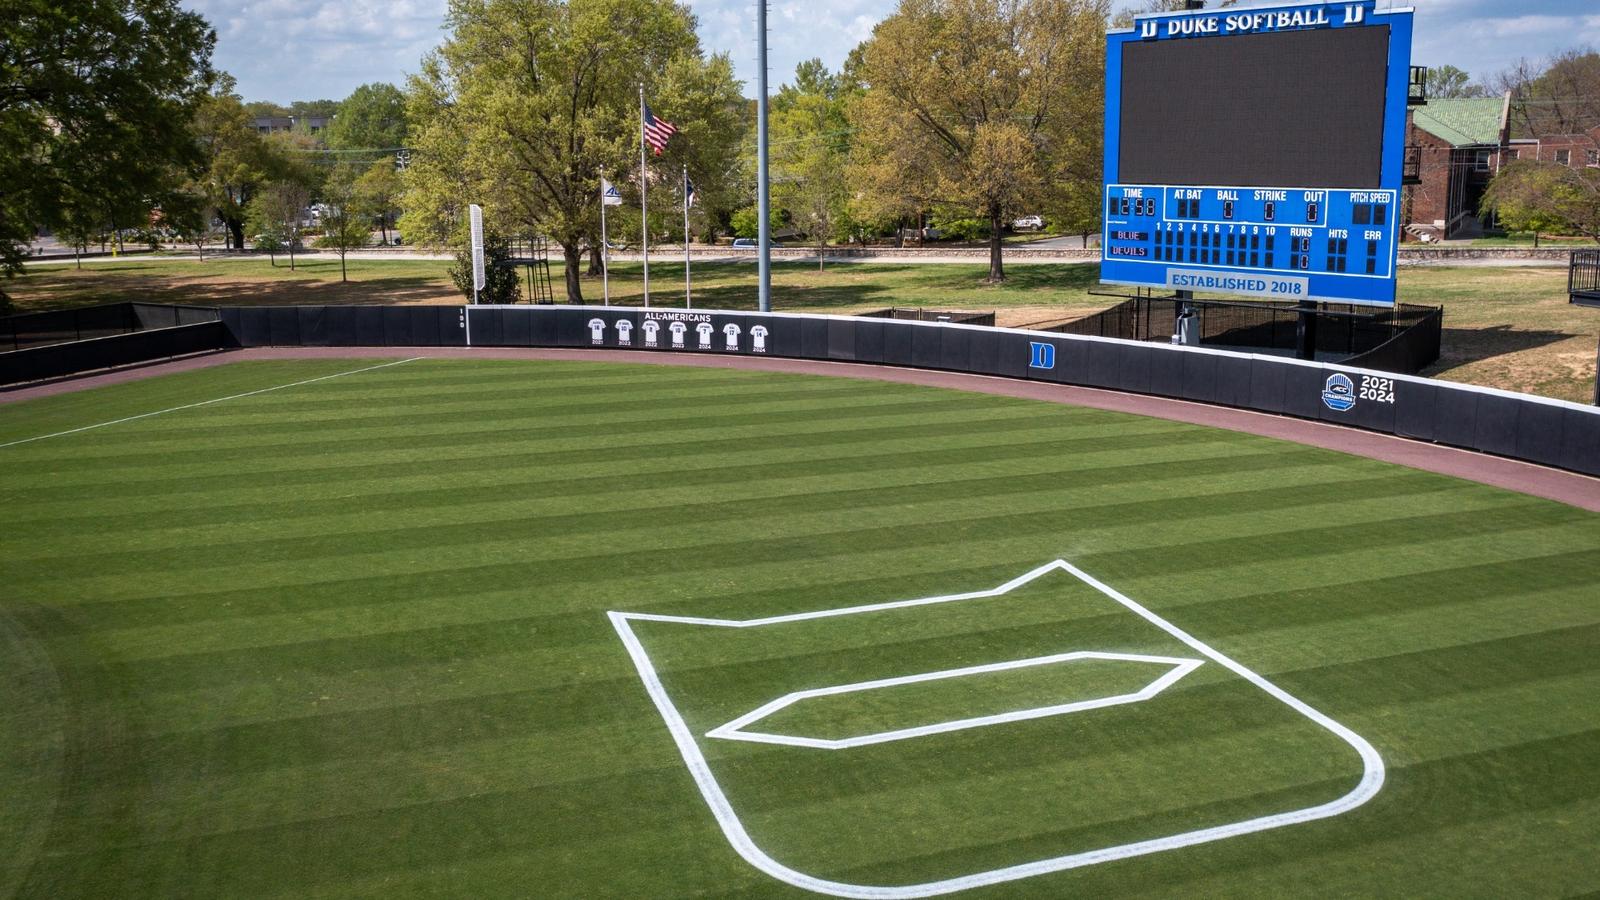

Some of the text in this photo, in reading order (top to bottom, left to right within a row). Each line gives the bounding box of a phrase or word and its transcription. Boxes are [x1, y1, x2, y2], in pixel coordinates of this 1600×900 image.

[1168, 16, 1219, 35] DUKE
[1225, 8, 1329, 31] SOFTBALL
[1123, 188, 1143, 198] TIME
[1174, 190, 1203, 200] AT BAT
[1217, 190, 1239, 200] BALL
[1254, 190, 1287, 201] STRIKE
[1304, 191, 1324, 202] OUT
[1350, 192, 1390, 203] PITCH SPEED
[1265, 202, 1275, 220] 0
[1307, 203, 1318, 221] 0
[1117, 231, 1141, 241] BLUE
[1156, 222, 1381, 240] 1 2 3 4 5 6 7 8 9 10 RUNS HITS ERR
[1112, 246, 1145, 257] DEVILS
[1172, 274, 1302, 294] ESTABLISHED 2018
[645, 312, 711, 322] ALL-AMERICANS
[1362, 376, 1394, 391] 2021
[1360, 387, 1394, 403] 2024
